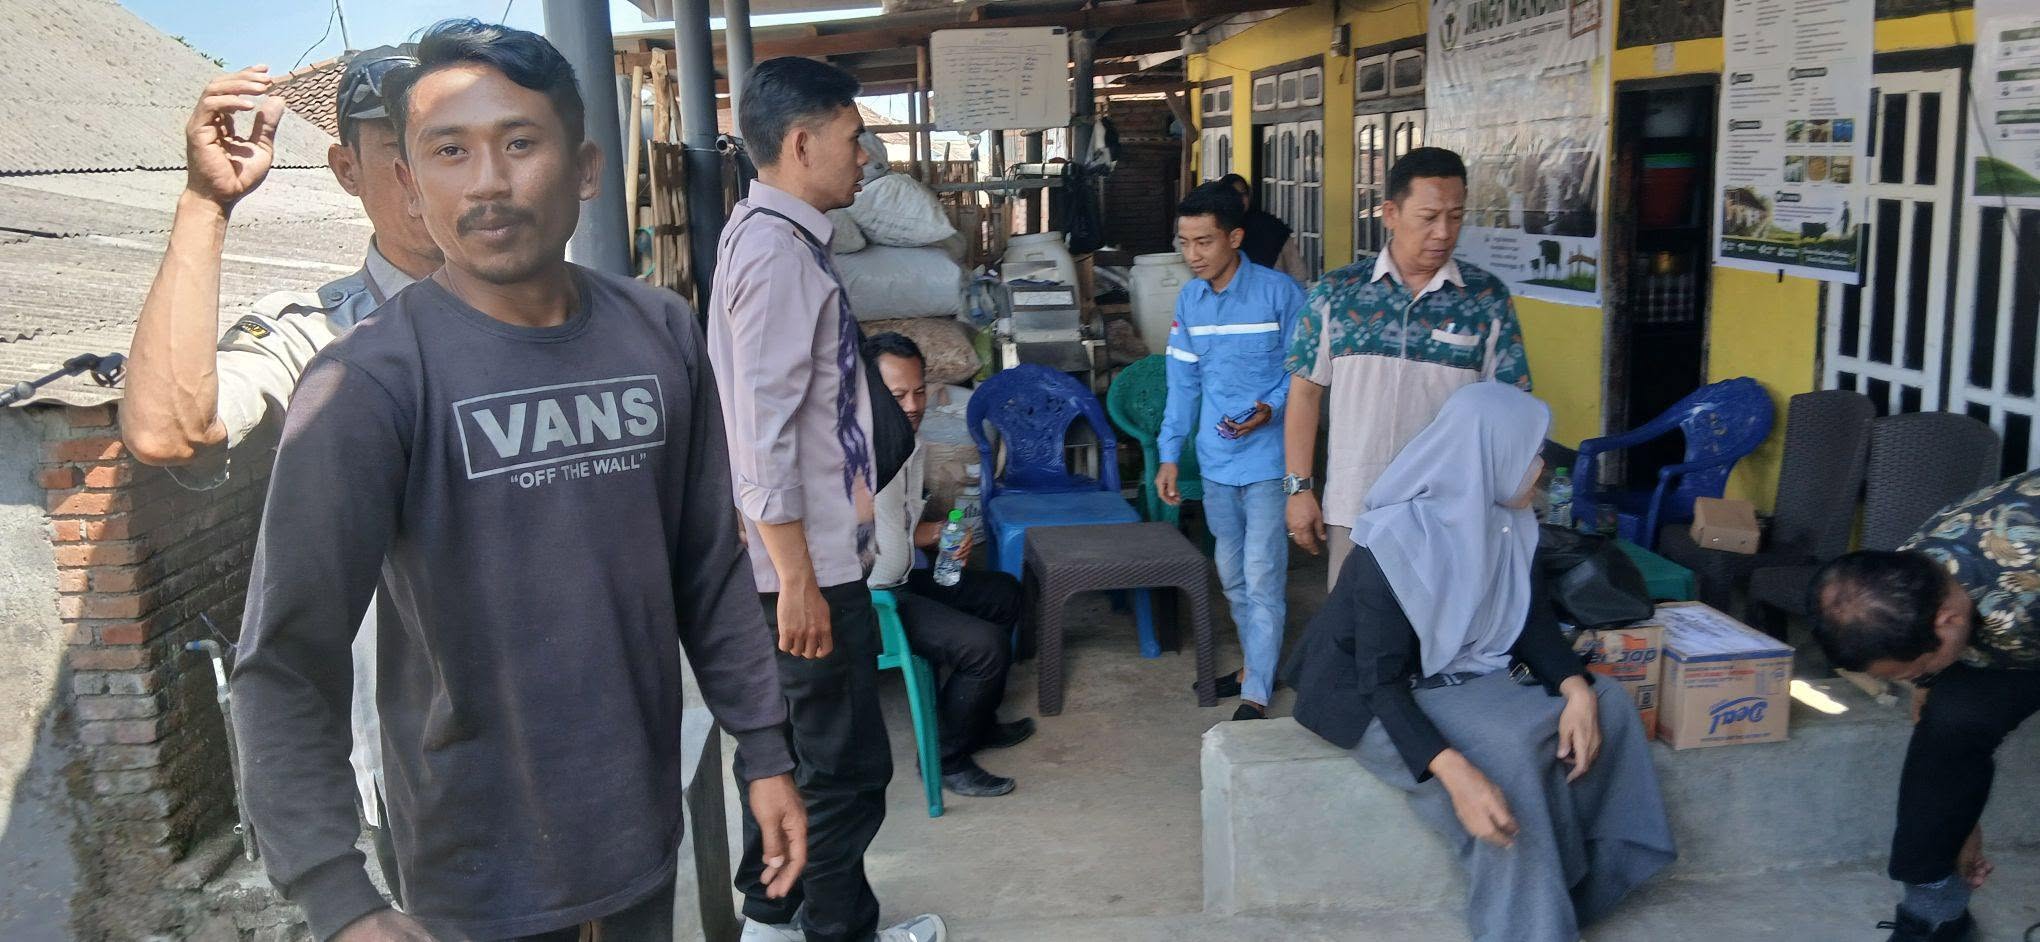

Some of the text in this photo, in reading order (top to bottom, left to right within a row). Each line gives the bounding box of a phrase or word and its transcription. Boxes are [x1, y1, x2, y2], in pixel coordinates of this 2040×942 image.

[472, 388, 658, 458] VANS
[561, 463, 591, 481] THE
[1709, 702, 1768, 735] Deal
